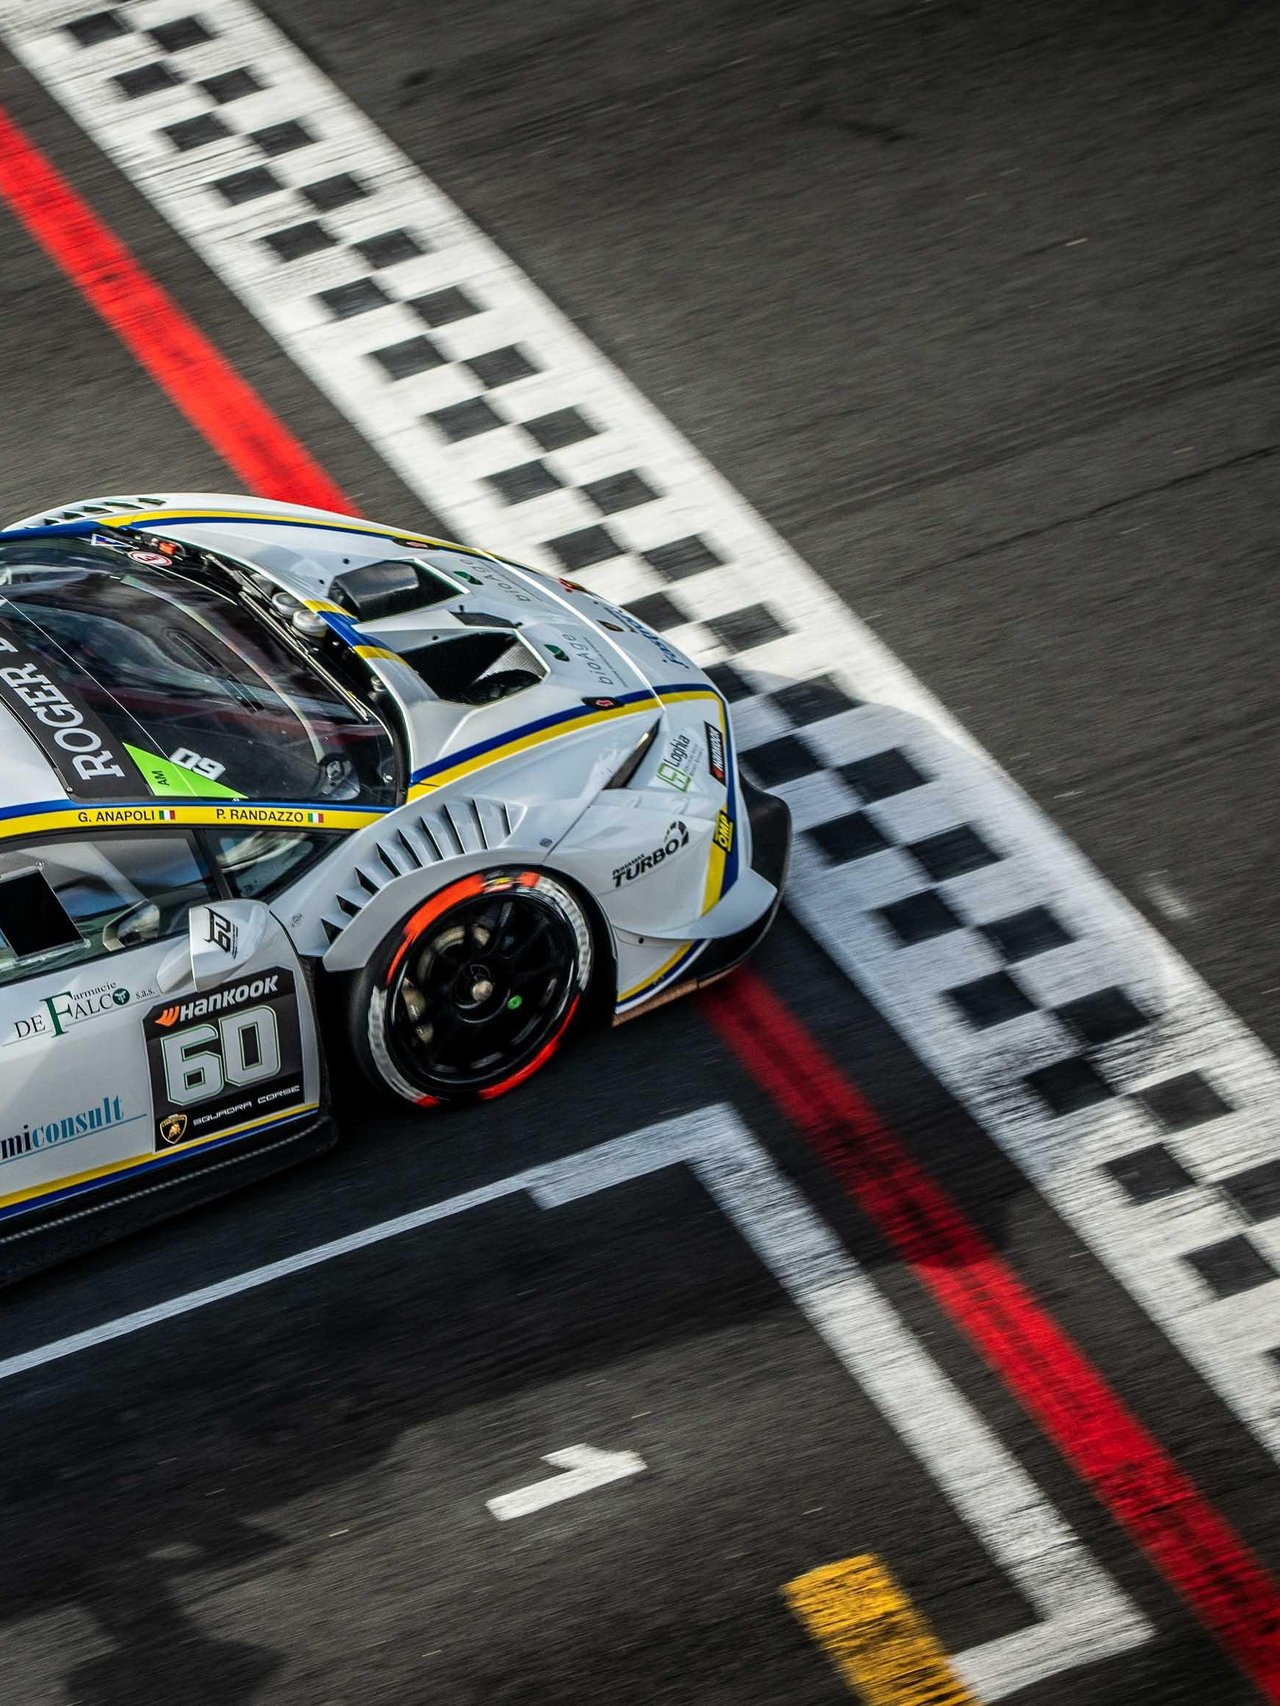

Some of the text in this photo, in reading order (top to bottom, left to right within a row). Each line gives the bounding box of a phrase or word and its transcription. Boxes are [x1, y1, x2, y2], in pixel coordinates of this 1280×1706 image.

[562, 633, 614, 686] bioAge
[150, 770, 170, 786] AM
[78, 809, 157, 824] G. ANAPOLI
[216, 809, 304, 823] P. RANDAZZO
[717, 814, 733, 848] OMP
[612, 838, 680, 888] TURBO
[13, 1016, 46, 1039] DE
[160, 1005, 282, 1106] 60
[192, 1101, 253, 1127] SQUADRA
[258, 1084, 301, 1104] CORSE
